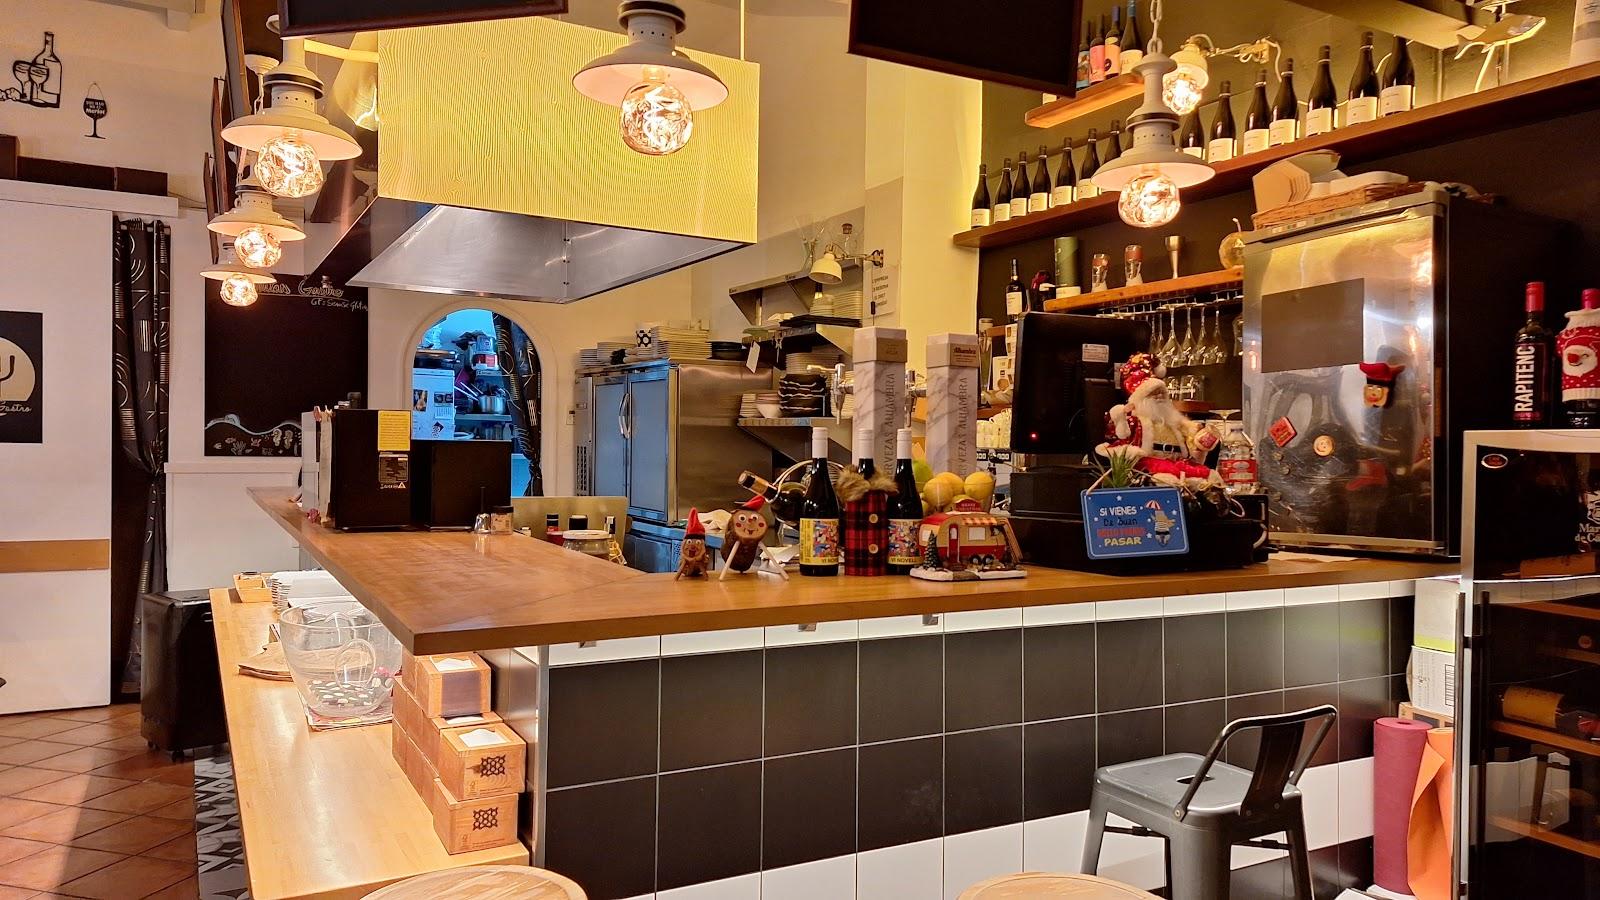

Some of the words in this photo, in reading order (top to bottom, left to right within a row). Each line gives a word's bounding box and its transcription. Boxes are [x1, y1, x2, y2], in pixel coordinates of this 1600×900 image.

[1514, 345, 1536, 412] RAPITENC
[1104, 537, 1142, 547] PASAR
[1574, 533, 1586, 542] de
